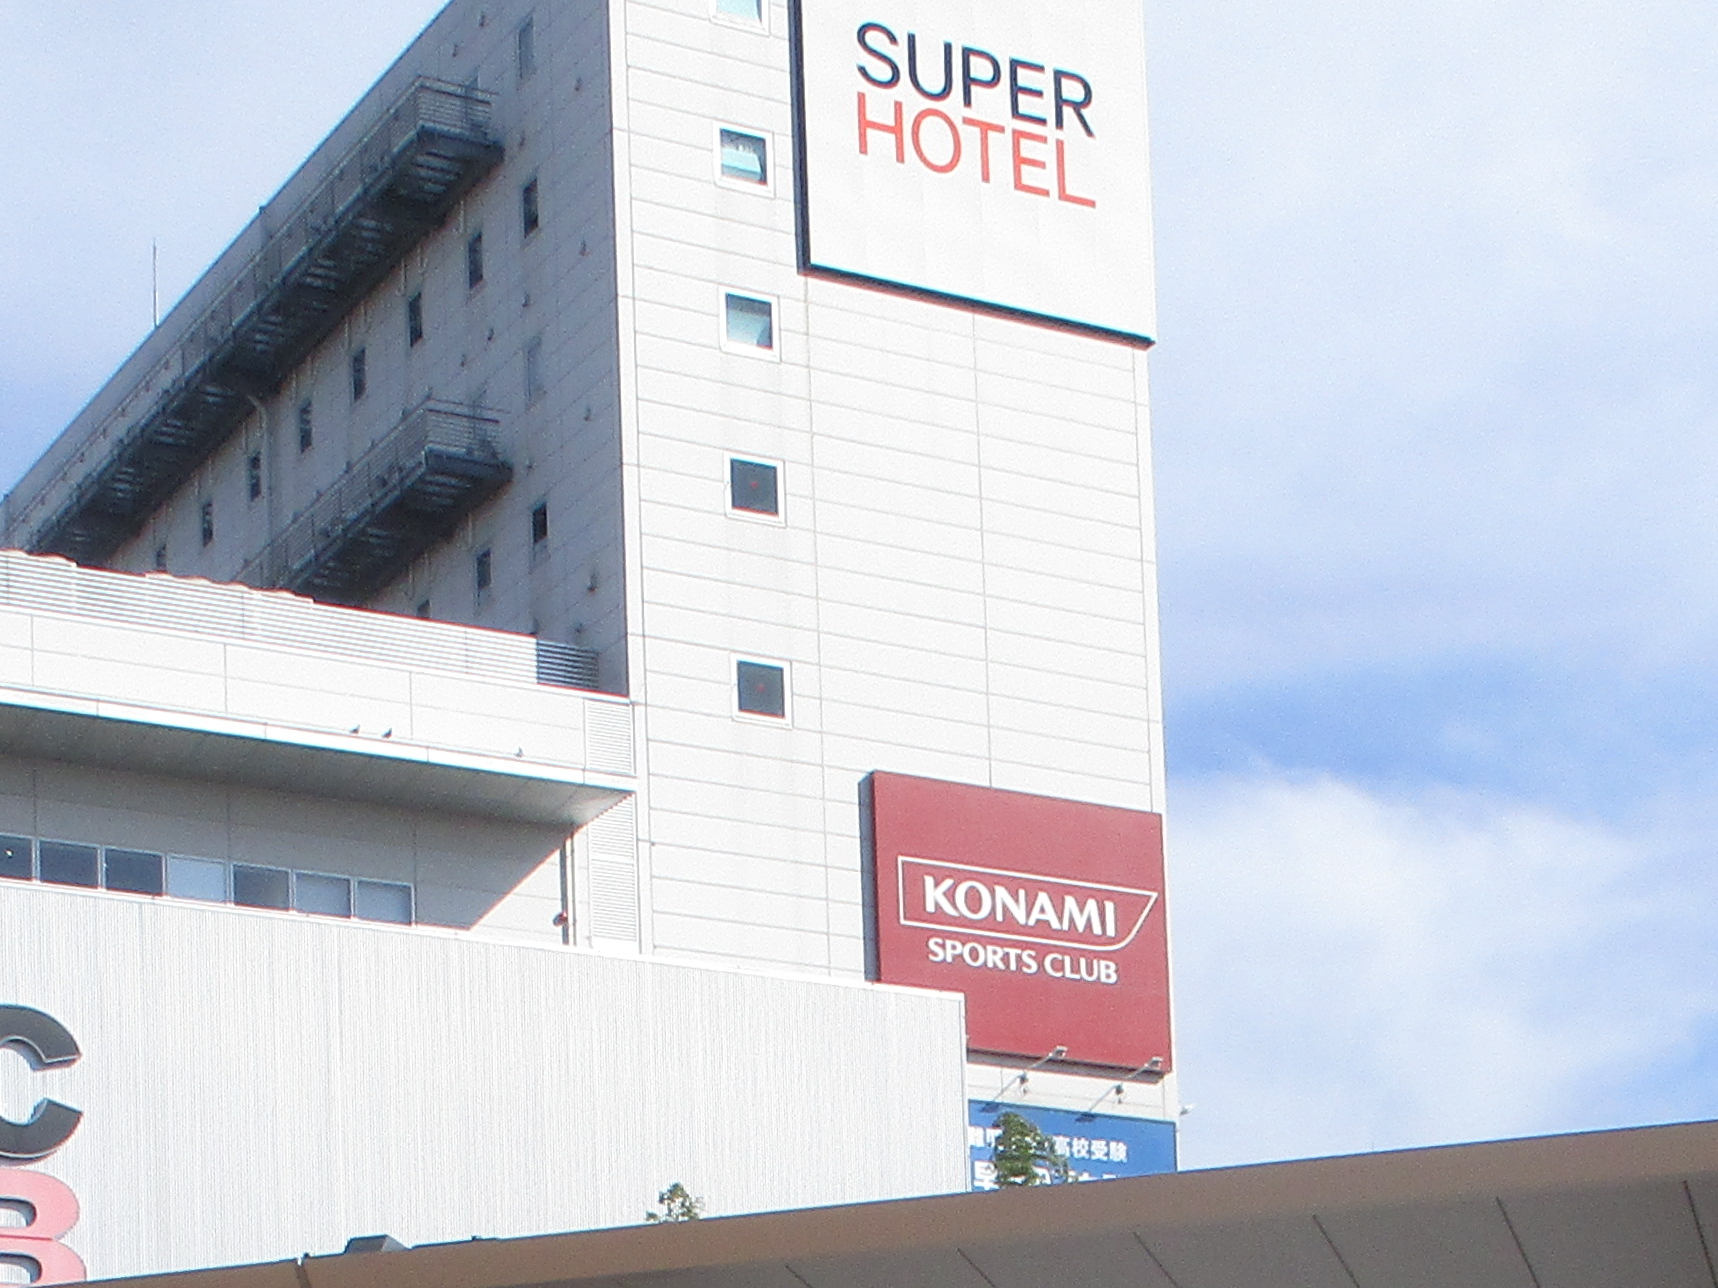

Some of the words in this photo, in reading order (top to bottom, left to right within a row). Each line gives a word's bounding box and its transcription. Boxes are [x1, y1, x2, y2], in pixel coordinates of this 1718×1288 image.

[856, 21, 1096, 138] SUPER
[857, 91, 1096, 208] HOTEL
[923, 874, 1116, 938] KONAMI
[927, 937, 1038, 975] SPORTS
[1044, 953, 1118, 985] CLUB
